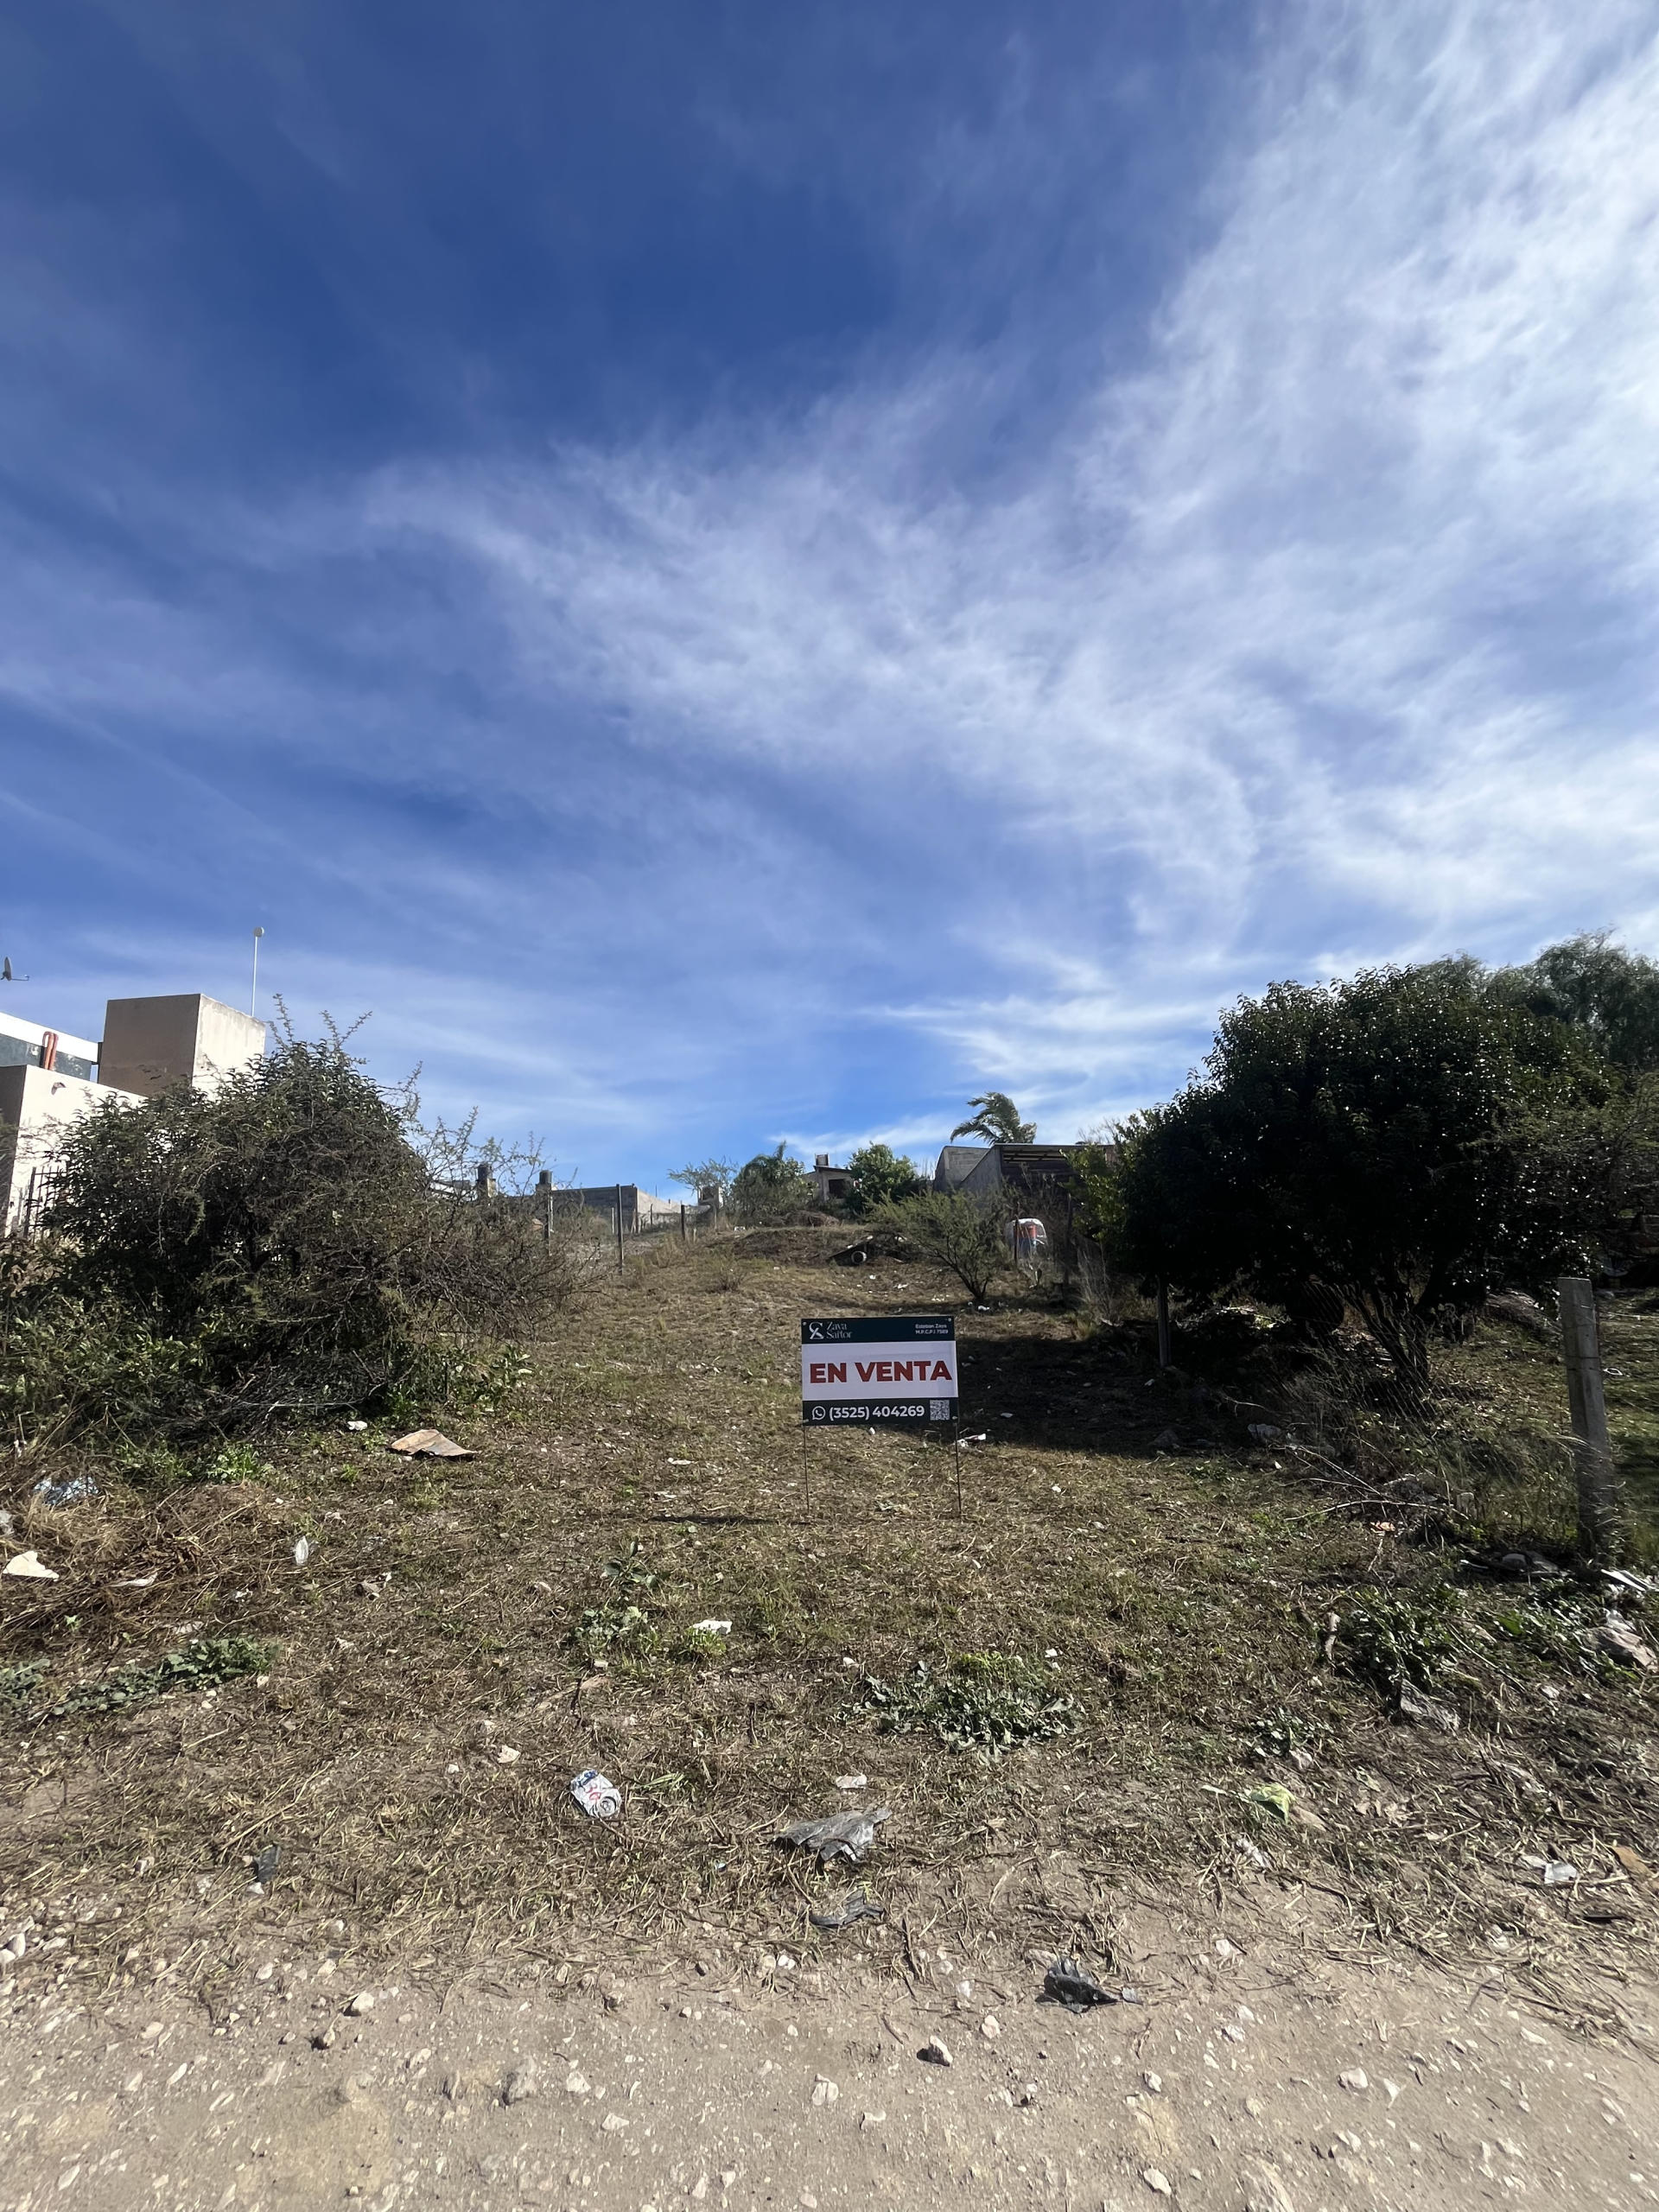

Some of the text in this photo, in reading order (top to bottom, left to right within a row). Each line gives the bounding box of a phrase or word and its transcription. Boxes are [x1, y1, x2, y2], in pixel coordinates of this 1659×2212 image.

[810, 1360, 952, 1383] EN VENTA
[829, 1405, 925, 1421] (3525) 404269
